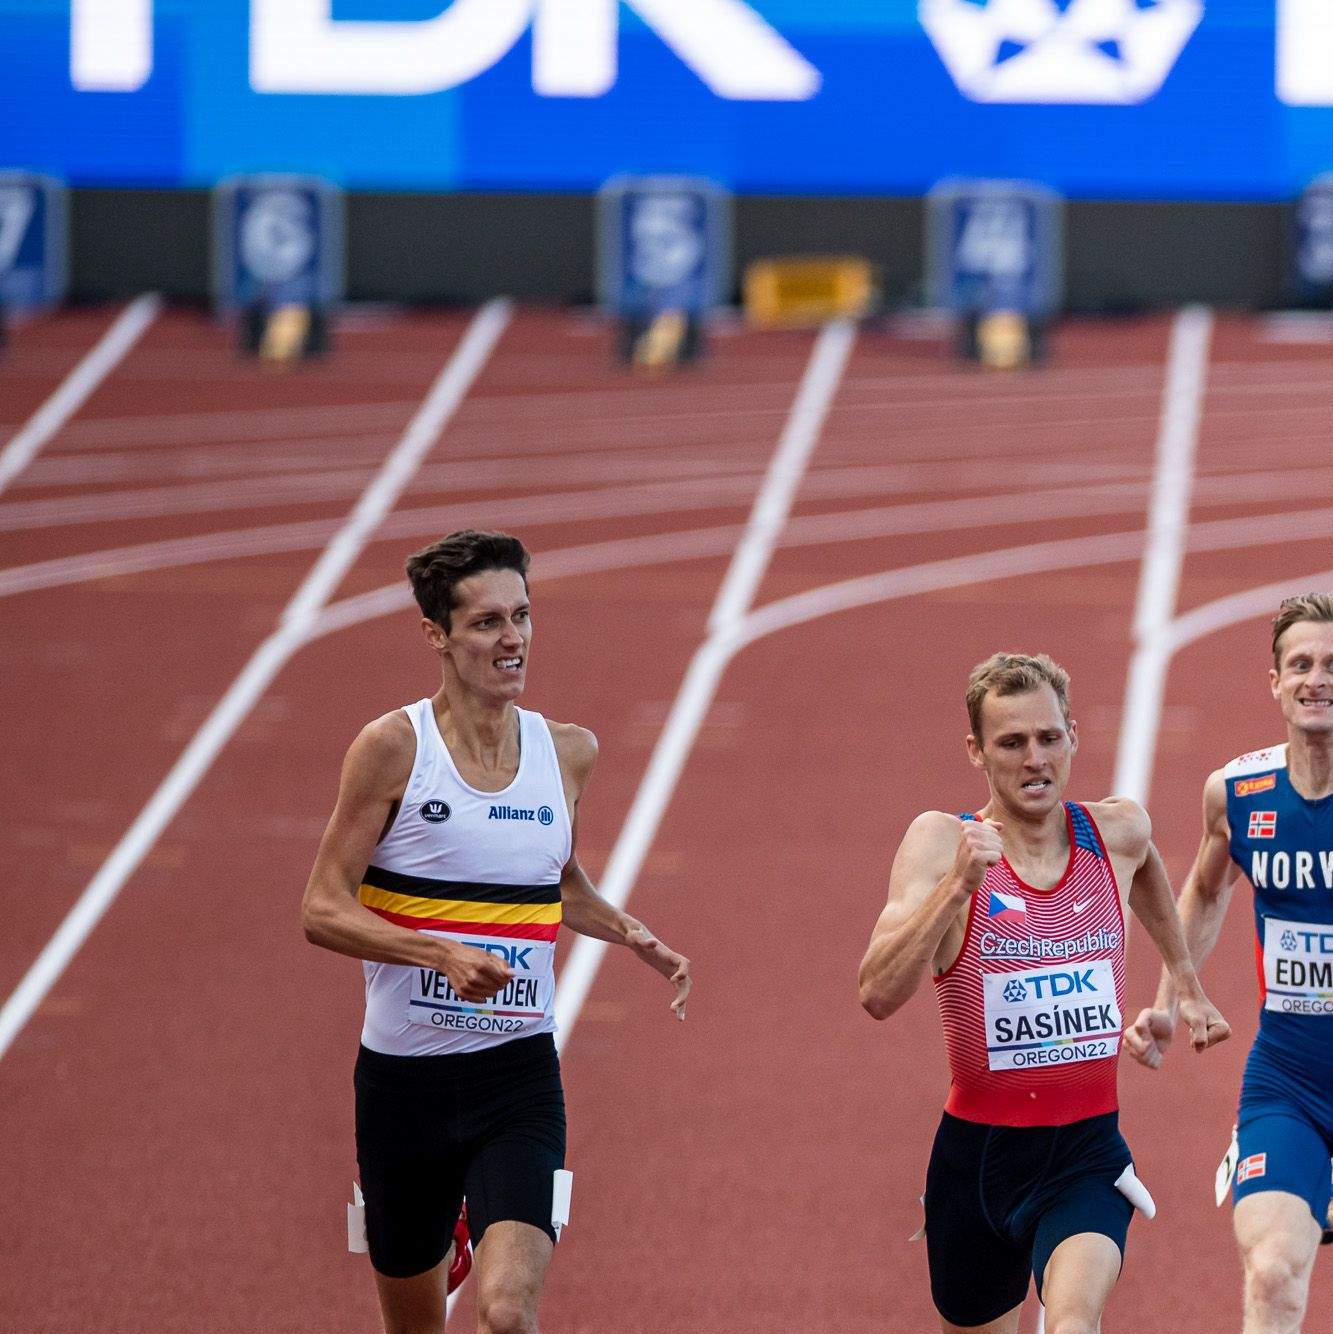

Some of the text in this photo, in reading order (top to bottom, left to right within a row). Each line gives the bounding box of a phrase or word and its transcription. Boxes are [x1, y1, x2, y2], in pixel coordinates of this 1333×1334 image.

[241, 191, 314, 281] 6
[631, 197, 702, 287] 5
[488, 806, 534, 820] Allianz
[1025, 969, 1098, 999] TDK
[431, 1012, 523, 1032] OREGON22
[995, 1004, 1116, 1043] SASÍNEK
[1013, 1042, 1107, 1066] OREGON22
